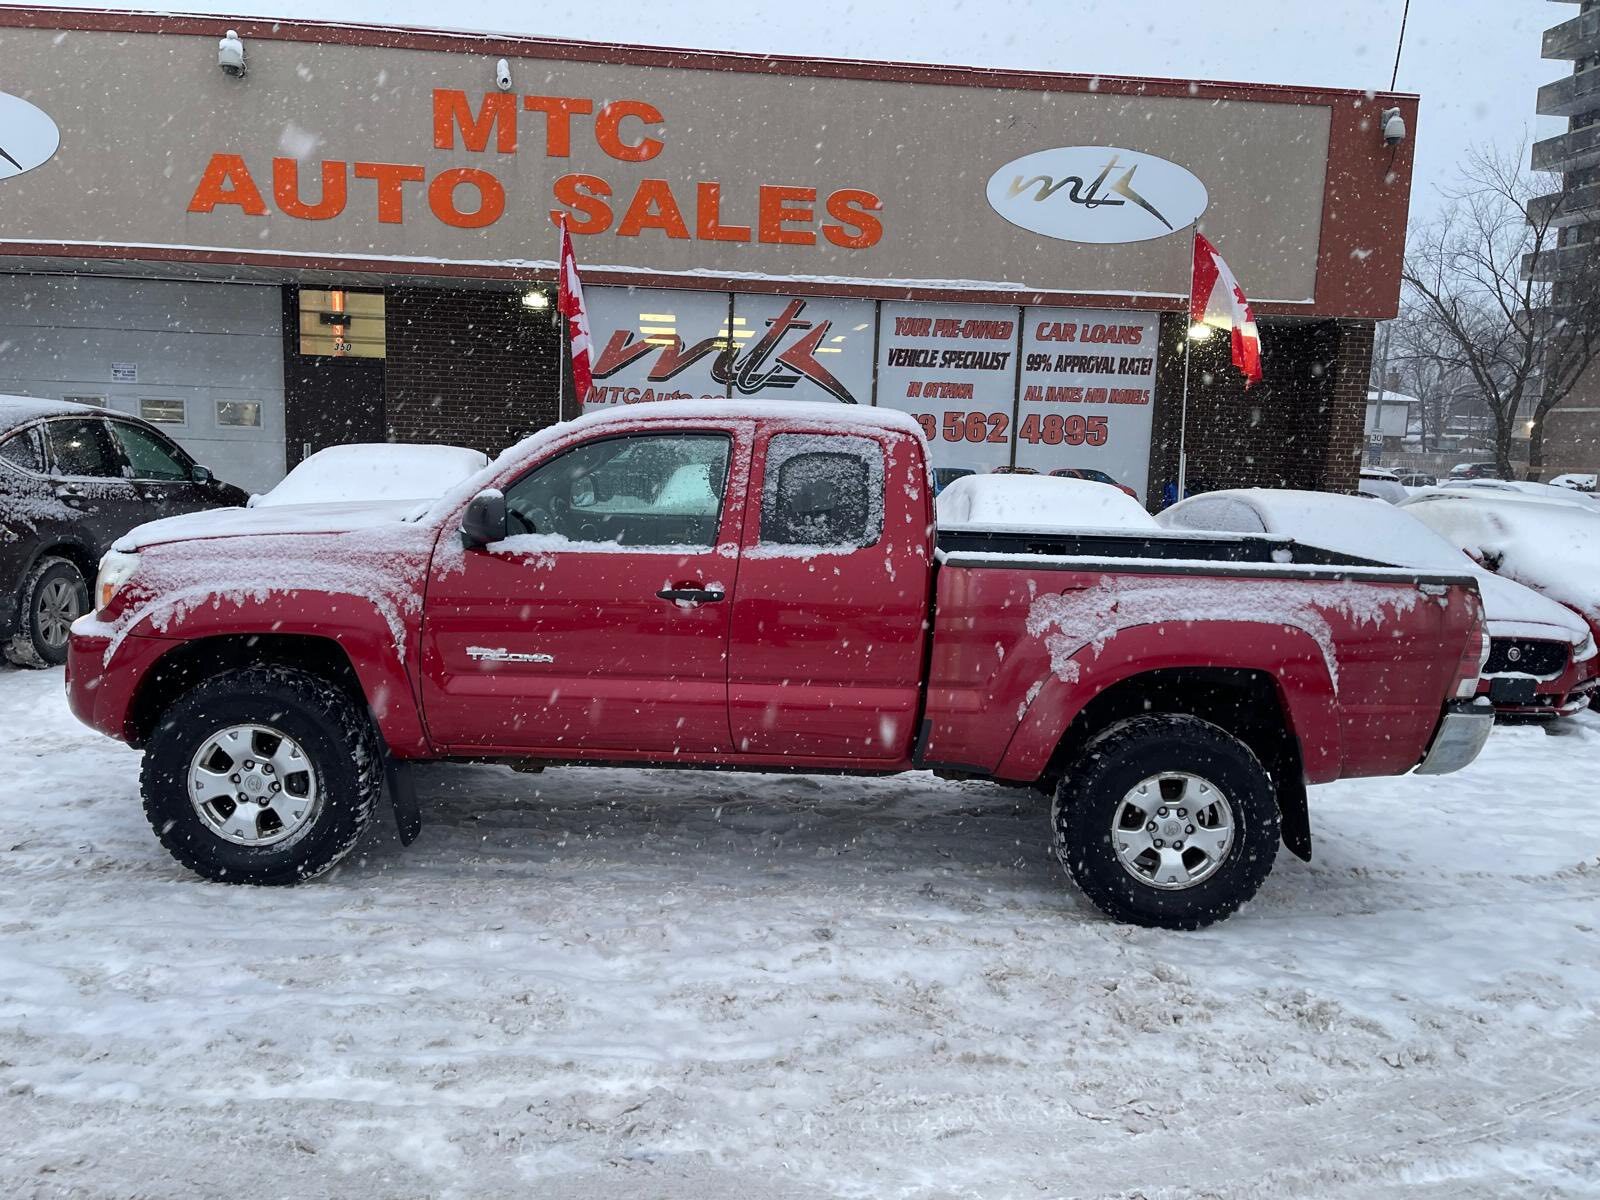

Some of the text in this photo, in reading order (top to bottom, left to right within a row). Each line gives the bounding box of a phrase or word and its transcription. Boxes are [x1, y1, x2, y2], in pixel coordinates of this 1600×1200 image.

[433, 88, 665, 162] MTC
[187, 153, 883, 249] AUTO SALES
[895, 317, 1013, 340] YOUR PRE-OWNED
[1035, 321, 1143, 345] CAR LOANS
[888, 348, 1011, 370] VEHICLE SPECIALIST
[1026, 353, 1153, 375] 99% APPROVAL RATE!
[907, 381, 974, 399] IN OTTAWA
[1024, 385, 1150, 405] ALL MAKES AND MODELS
[943, 411, 1010, 443] 562
[1019, 414, 1109, 446] 4895
[1371, 433, 1382, 441] 30
